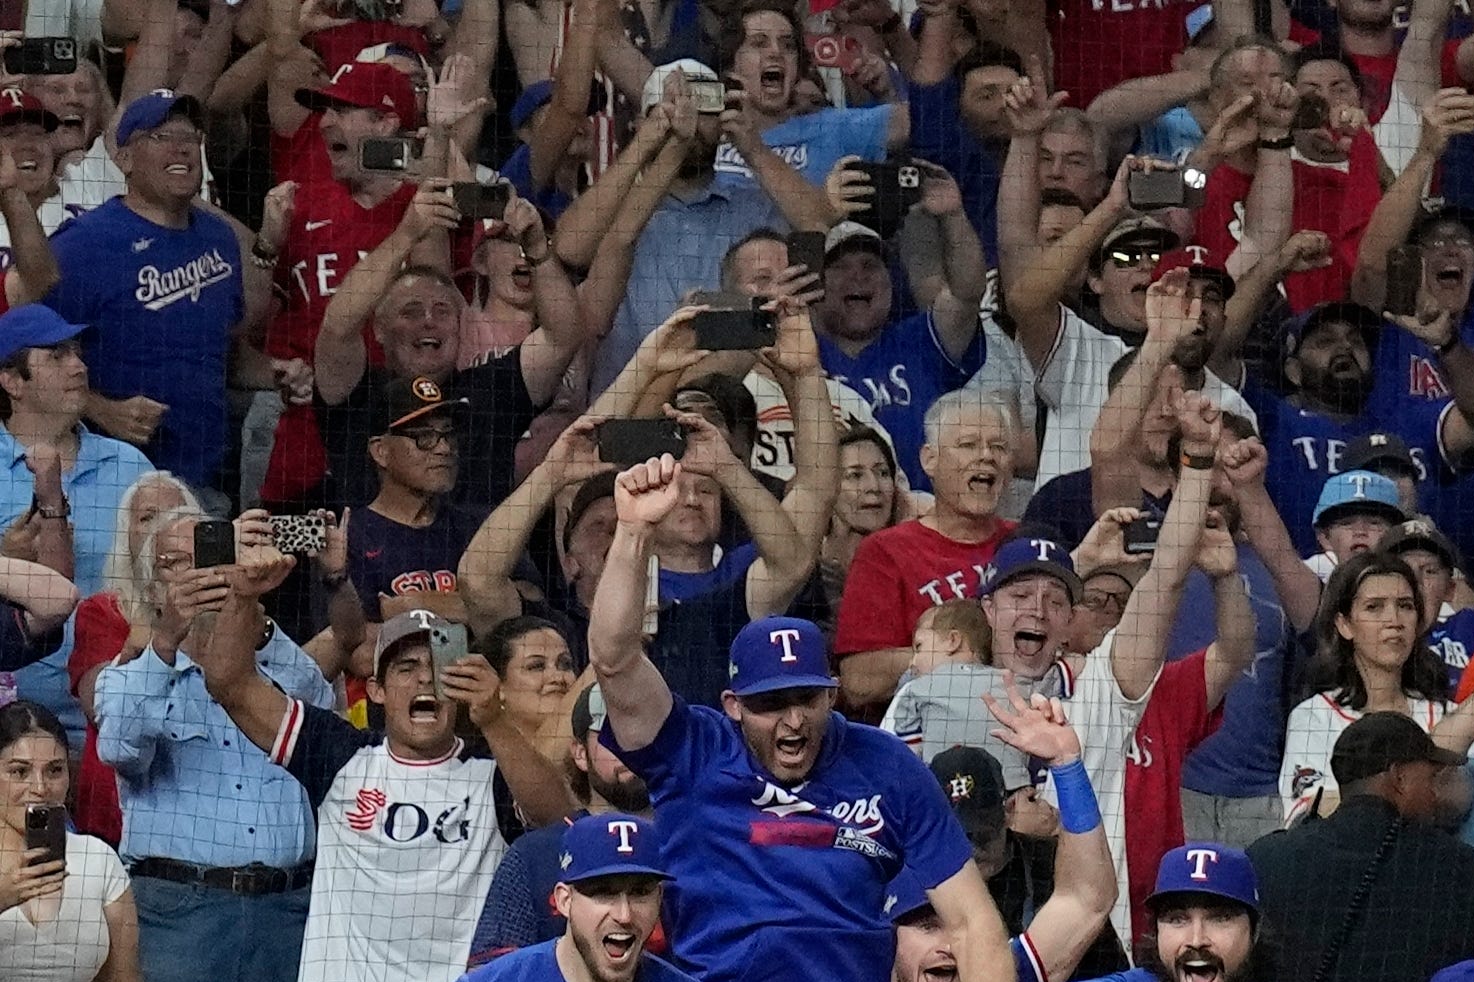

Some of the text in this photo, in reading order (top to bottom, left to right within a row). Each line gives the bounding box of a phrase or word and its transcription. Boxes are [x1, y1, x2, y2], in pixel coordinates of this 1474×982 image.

[136, 248, 233, 310] Rangers
[1292, 436, 1427, 481] TES
[1030, 538, 1056, 561] T
[770, 629, 799, 665] T
[608, 820, 638, 855] T
[1187, 849, 1217, 880] T
